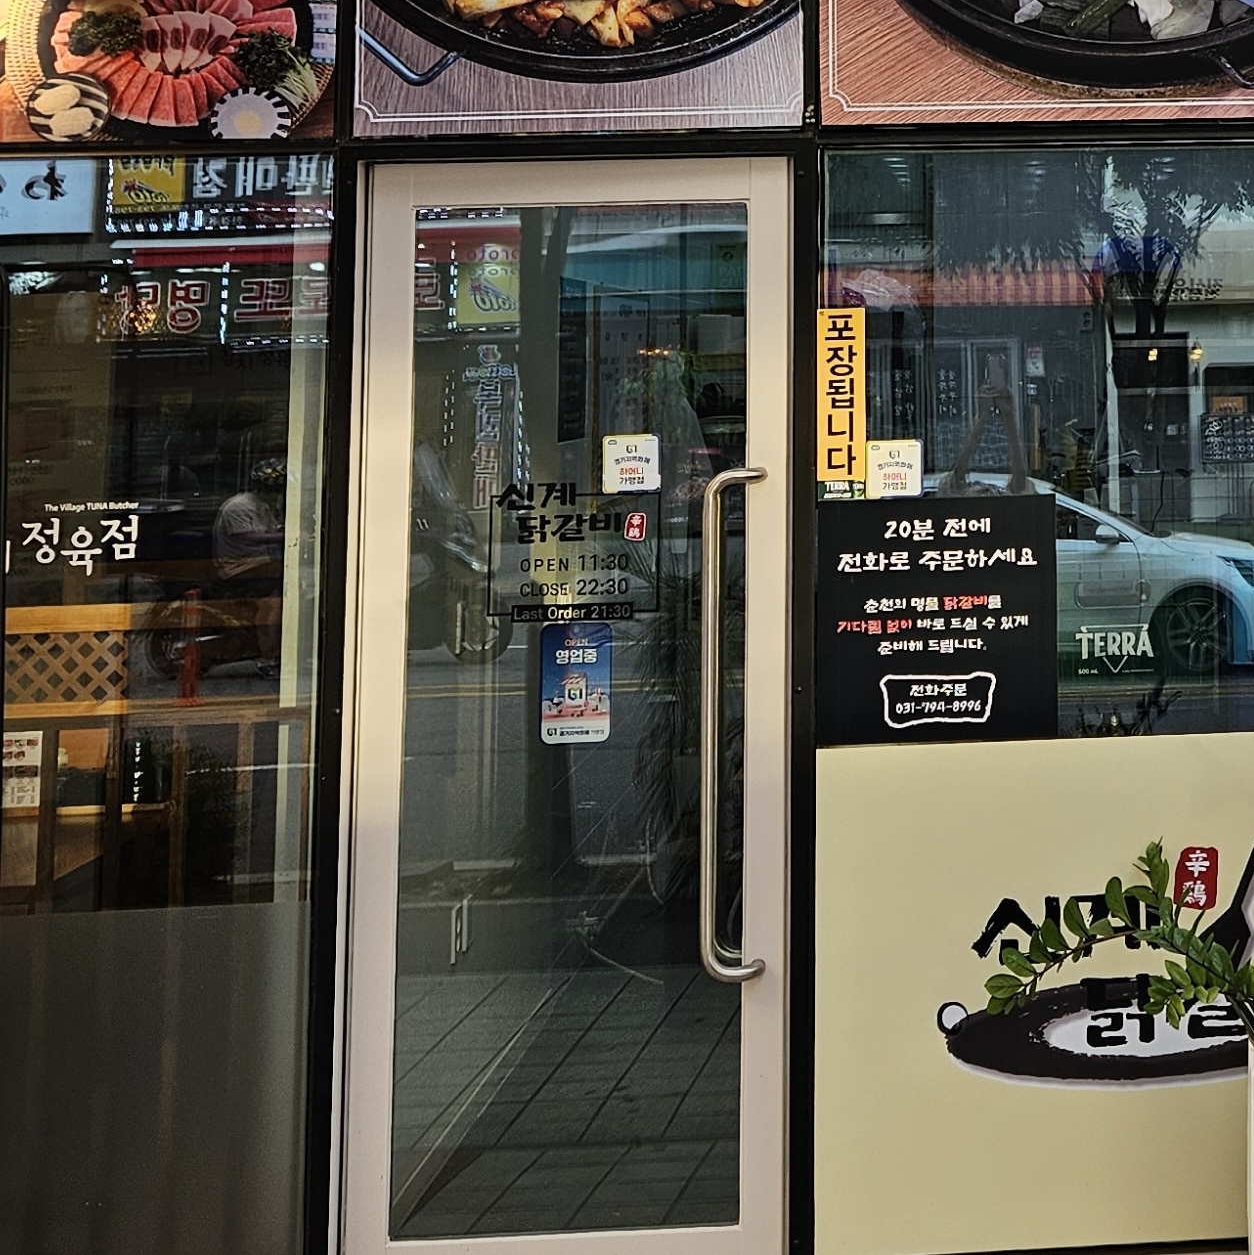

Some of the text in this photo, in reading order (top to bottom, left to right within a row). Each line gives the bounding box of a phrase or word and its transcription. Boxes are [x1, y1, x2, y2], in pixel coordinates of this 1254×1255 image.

[825, 313, 858, 476] 포장됩니다
[496, 482, 577, 511] 신계
[44, 501, 139, 513] The Village TUNA Butcher
[515, 512, 622, 545] 닭갈비
[884, 517, 991, 541] 20분 전에
[22, 515, 139, 577] 정육점
[519, 554, 629, 573] OPEN 11:30
[837, 547, 1038, 573] 전화로 주문하세요
[519, 578, 629, 597] CLOSE 22:30
[513, 605, 631, 620] Last Order 21:30
[910, 596, 940, 612] 명물
[943, 594, 1002, 611] 닭갈비를
[836, 615, 1029, 635] 기다림 없이 바로 드실 수 있게
[877, 637, 987, 655] 준비해 드립니다.
[1075, 630, 1154, 660] TERRA
[555, 648, 598, 665] 영업중
[909, 683, 968, 697] 전화주문
[895, 699, 982, 714] 031-794-8996
